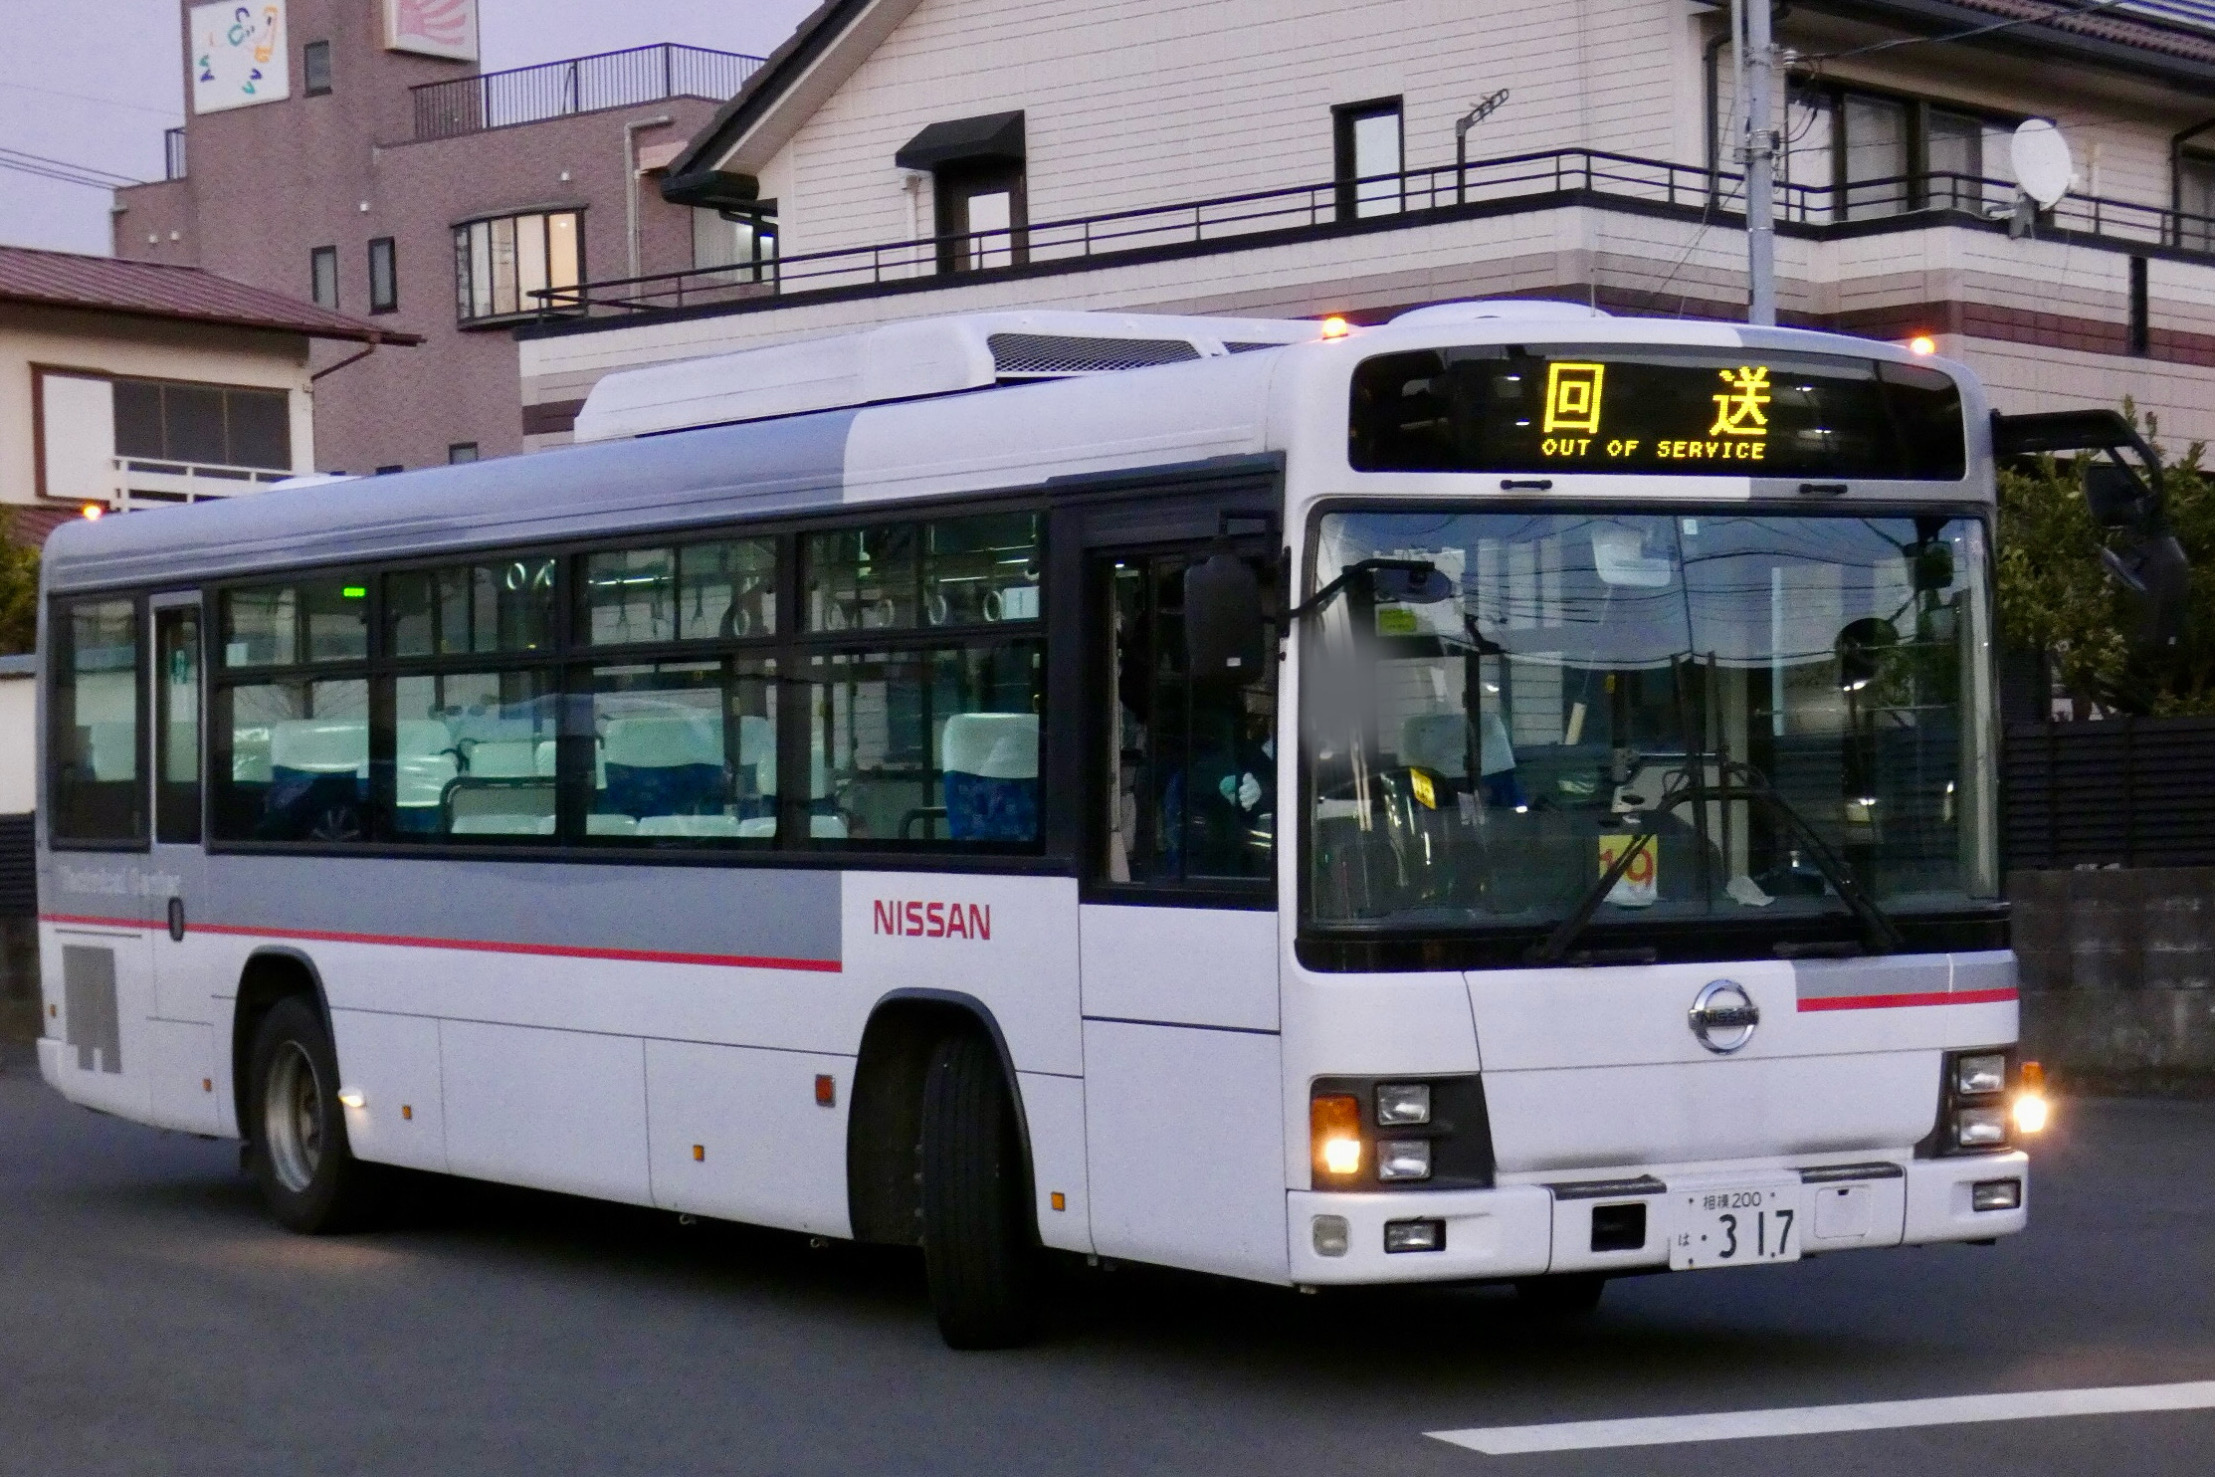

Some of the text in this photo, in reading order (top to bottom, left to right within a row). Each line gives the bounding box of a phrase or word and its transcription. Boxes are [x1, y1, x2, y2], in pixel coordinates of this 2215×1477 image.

[1542, 438, 1766, 460] OUT OF SERVICE
[874, 899, 991, 941] NISSAN
[1678, 1233, 1690, 1246] は
